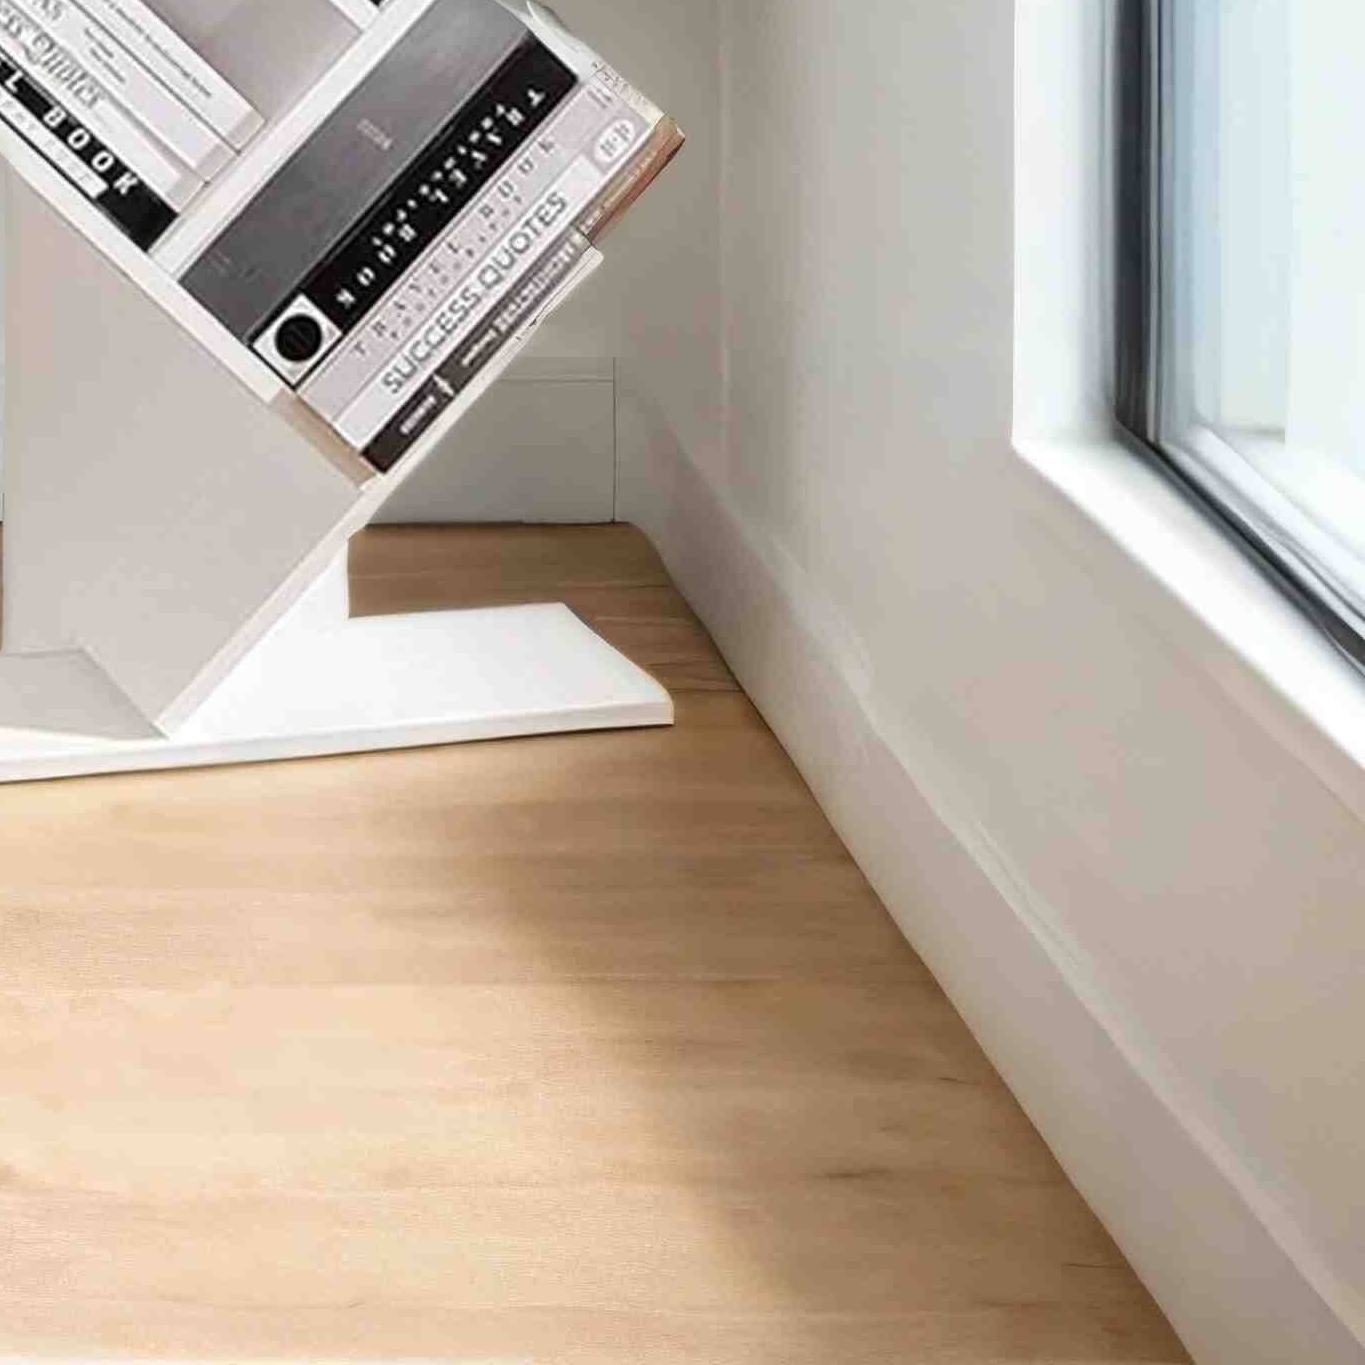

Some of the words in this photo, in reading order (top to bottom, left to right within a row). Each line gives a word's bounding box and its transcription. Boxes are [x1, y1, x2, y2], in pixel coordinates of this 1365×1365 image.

[40, 104, 142, 199] BOOK
[332, 221, 417, 310] BOOK
[380, 283, 484, 396] SUCCESS
[474, 188, 571, 294] QUOTES
